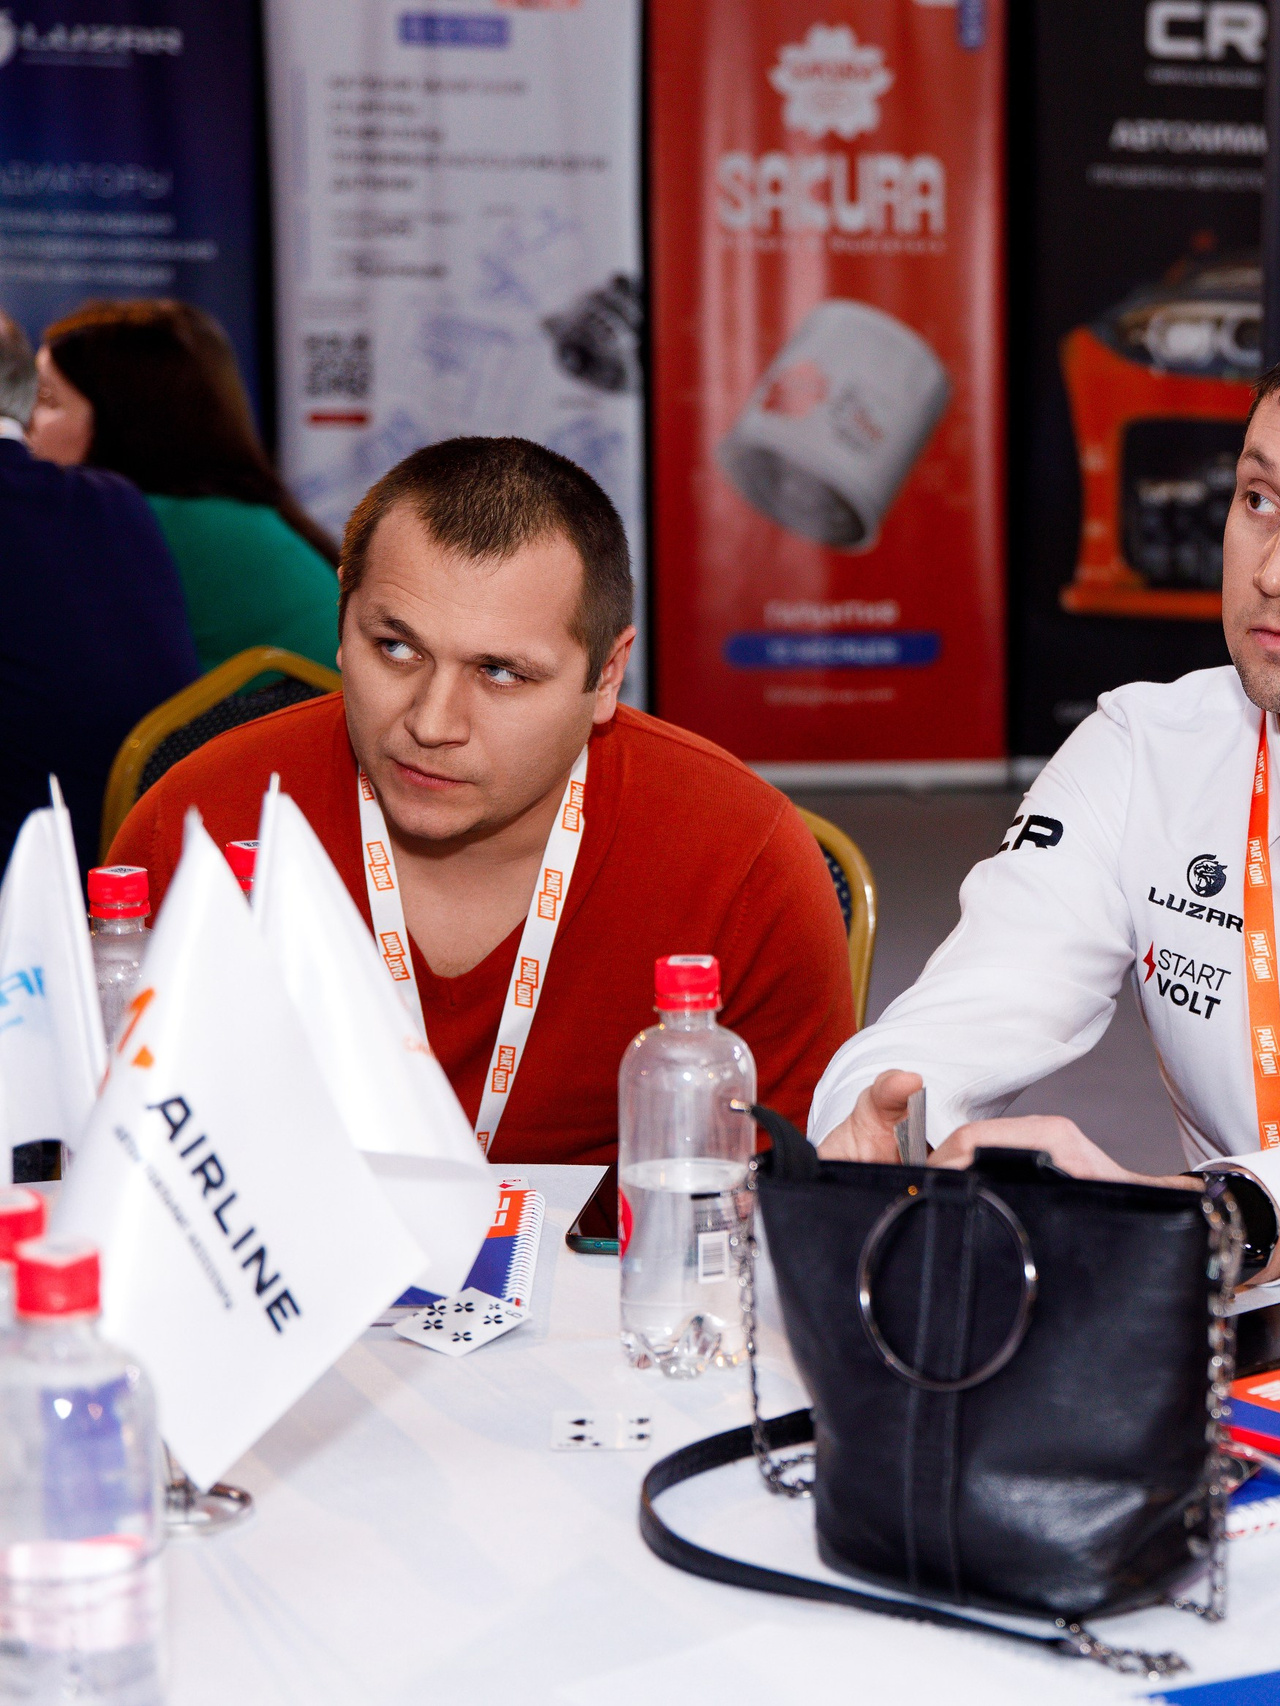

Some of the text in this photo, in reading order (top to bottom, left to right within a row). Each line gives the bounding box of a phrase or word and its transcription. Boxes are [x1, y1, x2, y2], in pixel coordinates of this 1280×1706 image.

[1146, 2, 1267, 61] CR
[718, 153, 946, 233] SAKURA
[995, 814, 1064, 855] R
[1148, 886, 1244, 933] LUZAR
[1158, 949, 1231, 991] START
[1157, 972, 1221, 1019] VOLT
[147, 1097, 300, 1334] AIRLINE
